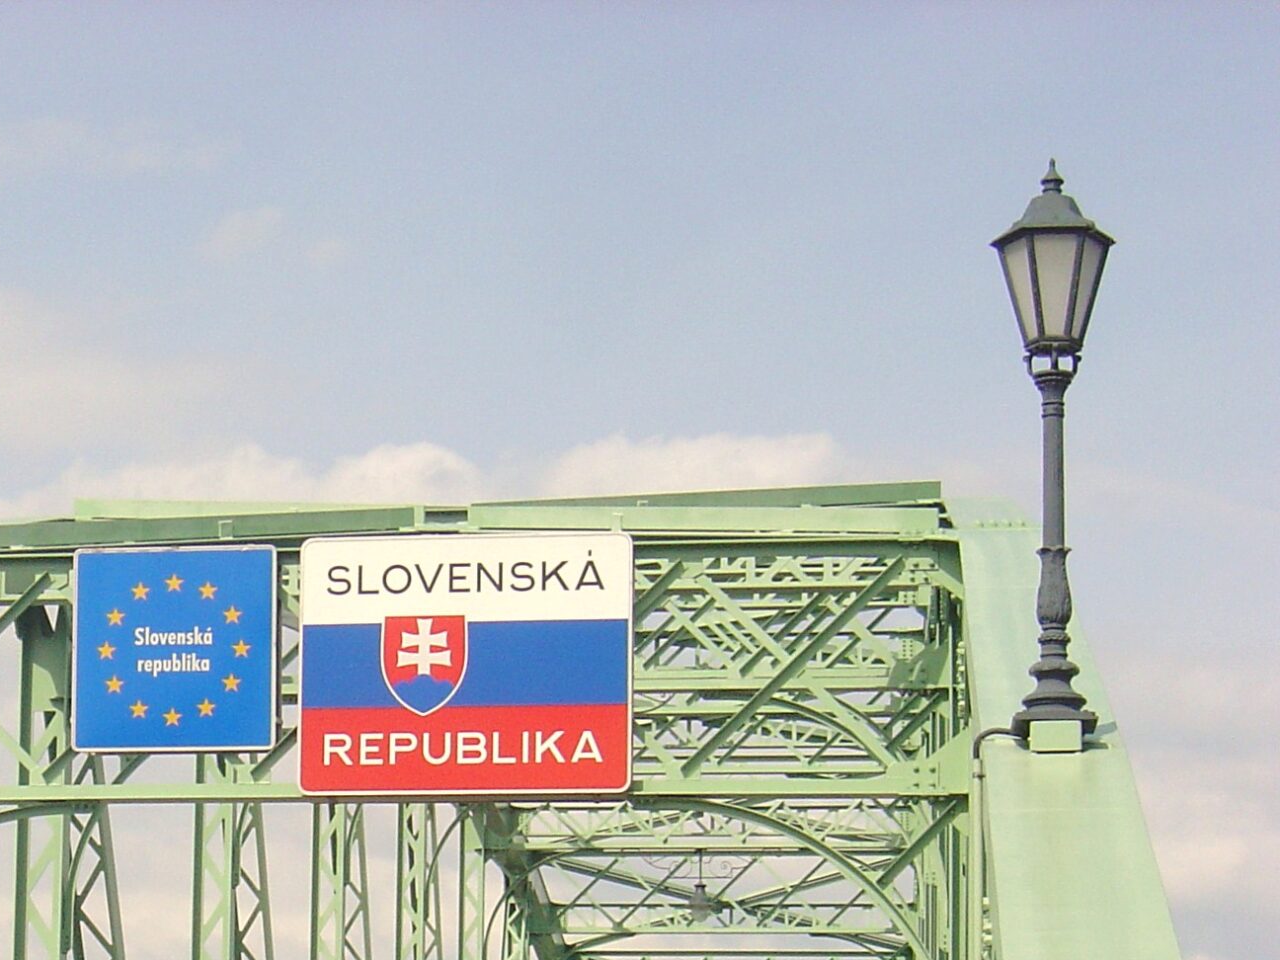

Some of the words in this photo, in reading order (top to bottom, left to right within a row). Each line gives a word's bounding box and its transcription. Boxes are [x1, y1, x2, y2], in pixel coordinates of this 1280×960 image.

[134, 626, 214, 647] Slovenská
[137, 654, 210, 677] republika
[322, 730, 604, 766] REPUBLIKA
